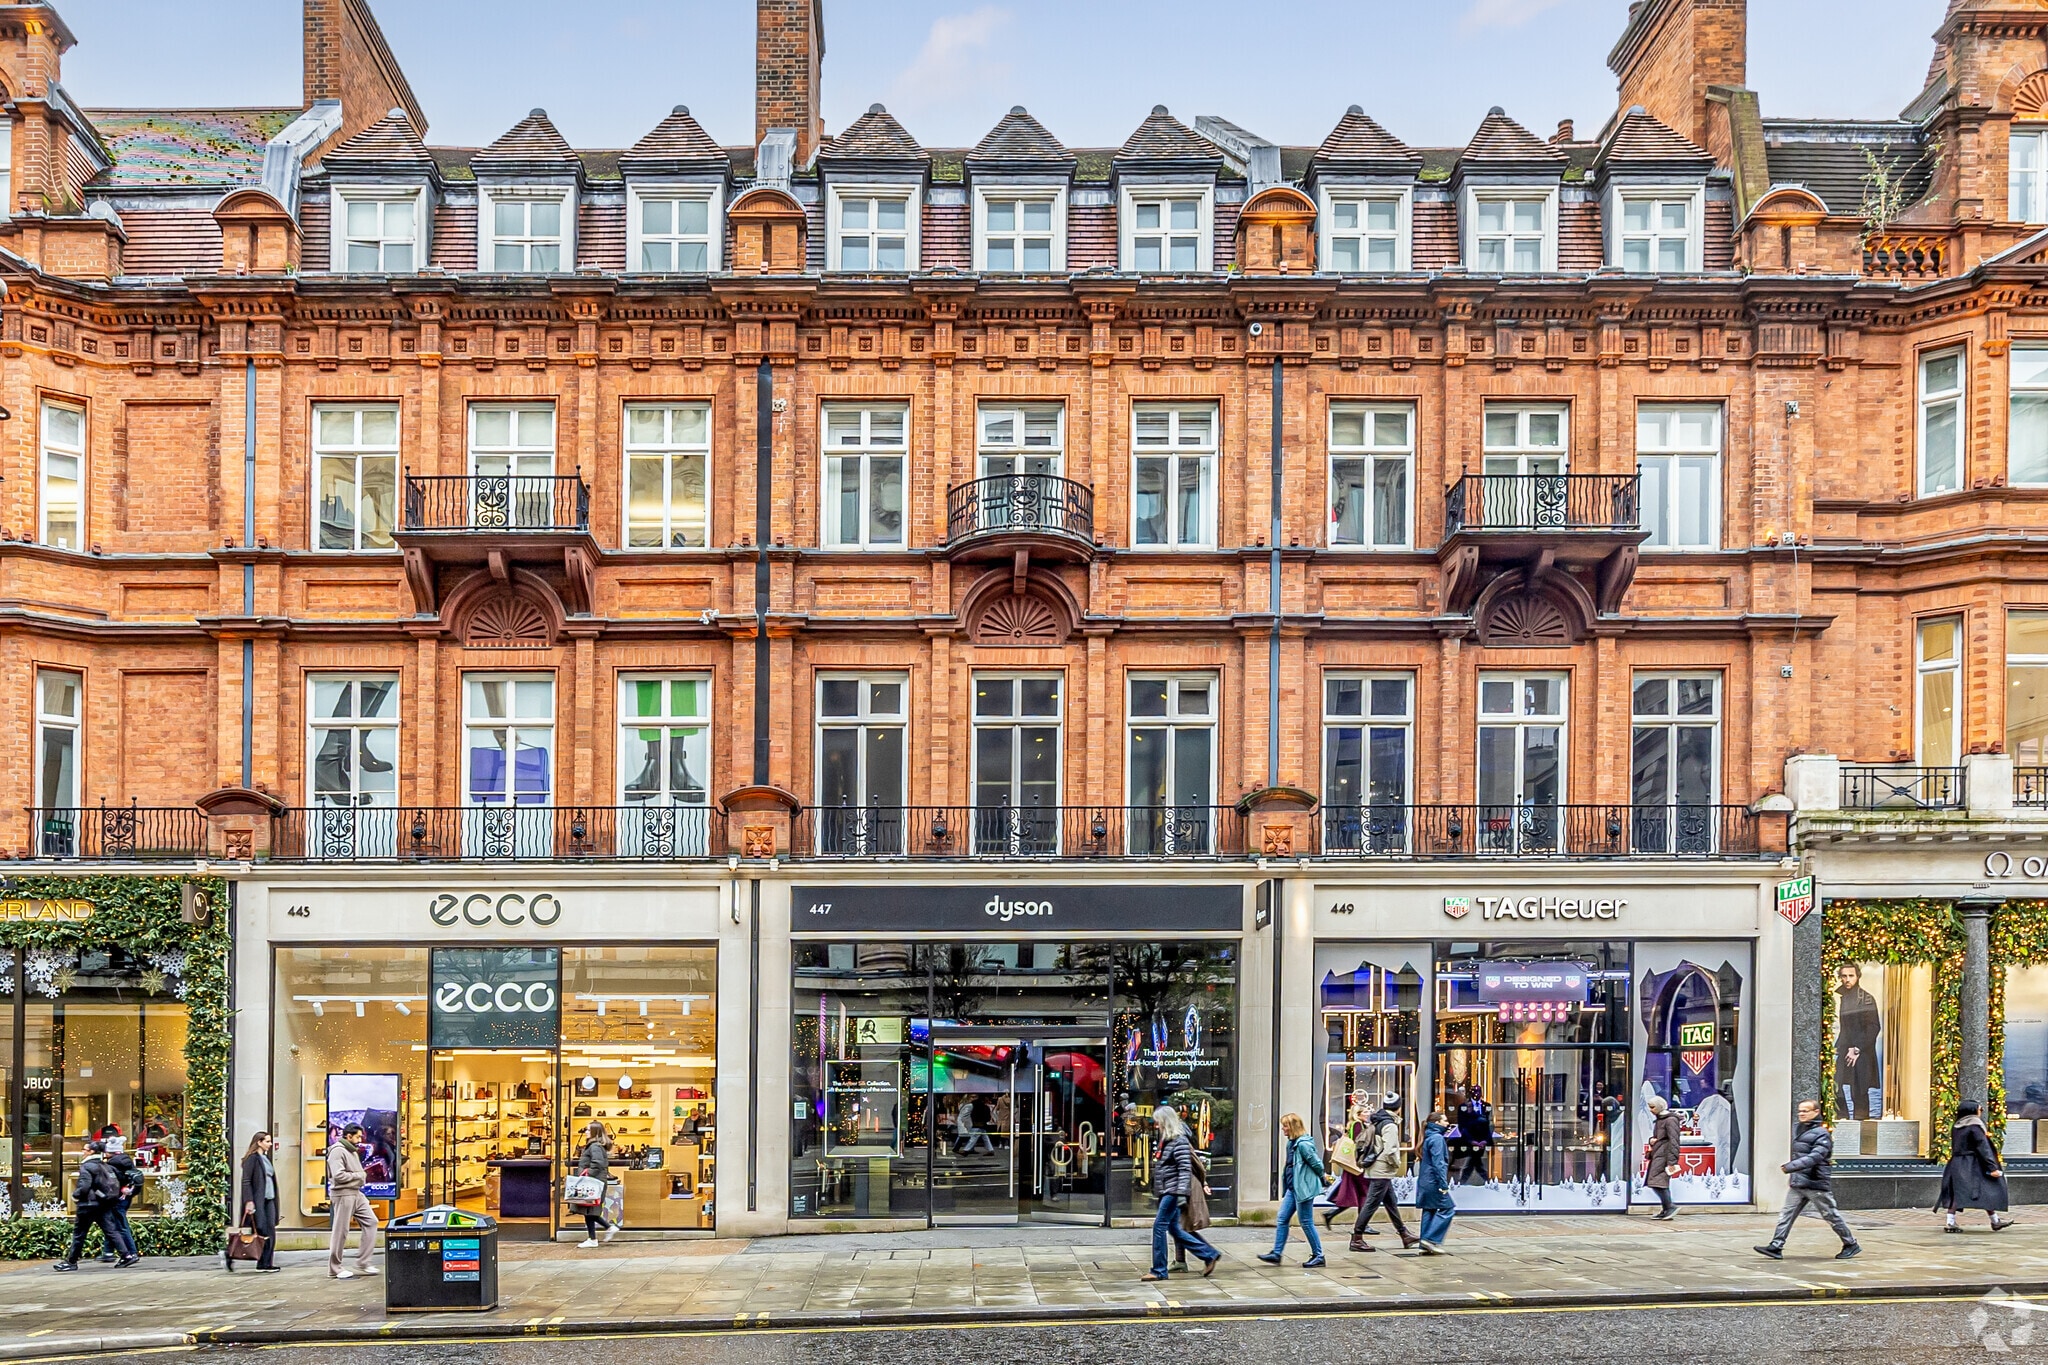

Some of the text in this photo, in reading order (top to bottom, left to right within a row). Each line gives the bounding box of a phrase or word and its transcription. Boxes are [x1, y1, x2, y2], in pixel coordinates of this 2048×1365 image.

[2022, 856, 2048, 877] O
[1780, 880, 1809, 898] TAG
[287, 906, 310, 918] 445
[430, 893, 562, 927] ecco
[809, 903, 832, 915] 447
[984, 895, 1053, 921] dyson
[1330, 903, 1355, 915] 449
[1780, 898, 1811, 921] HEUER
[1503, 975, 1563, 983] DESIGNED
[436, 982, 554, 1013] ecco
[1684, 1026, 1711, 1043] TAG
[1143, 1048, 1156, 1056] The
[1169, 1072, 1190, 1081] piston
